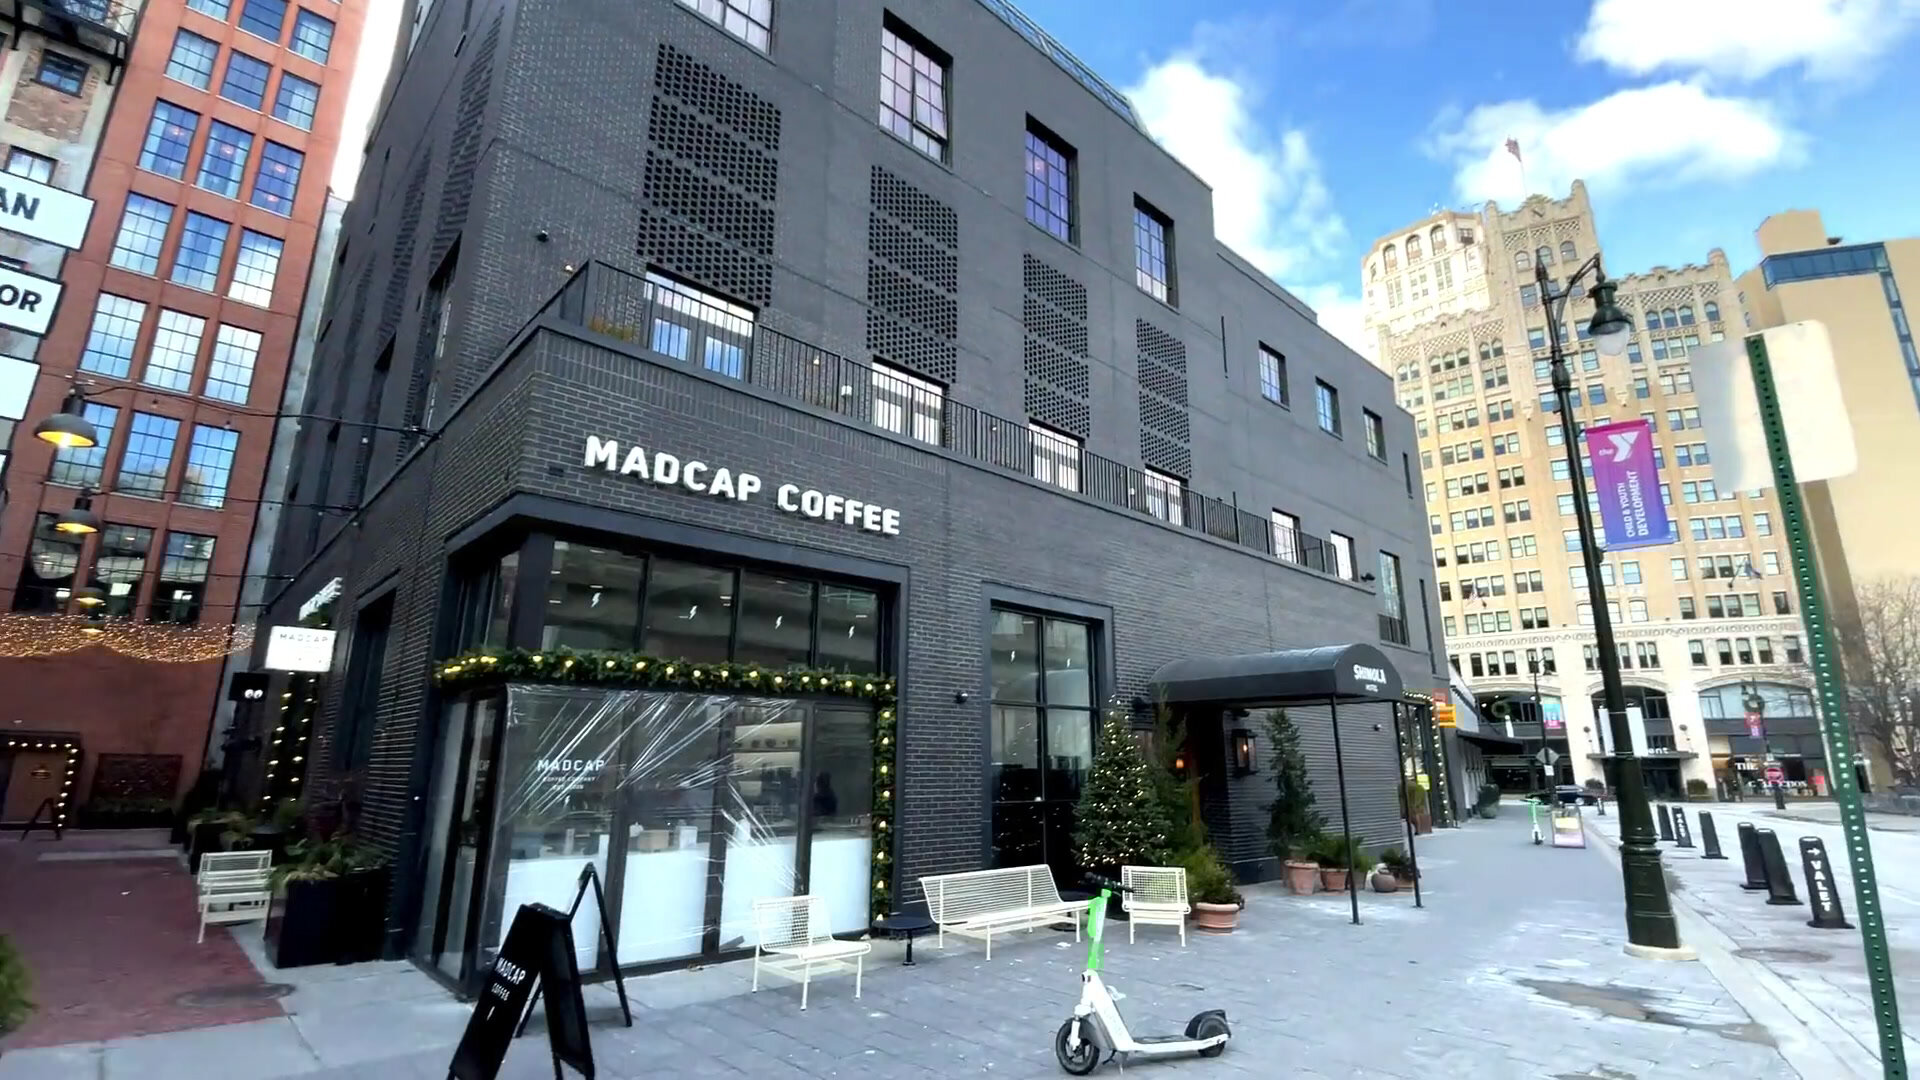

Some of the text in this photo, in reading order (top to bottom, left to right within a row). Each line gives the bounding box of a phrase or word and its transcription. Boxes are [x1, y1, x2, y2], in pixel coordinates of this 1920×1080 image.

[584, 435, 900, 535] MADCAP COFFEE
[1626, 470, 1649, 536] DEVELOPMENT
[1353, 664, 1387, 684] SHINOLA
[536, 759, 605, 772] MADCAP
[1810, 860, 1832, 912] VALET
[495, 957, 526, 985] MADCAP
